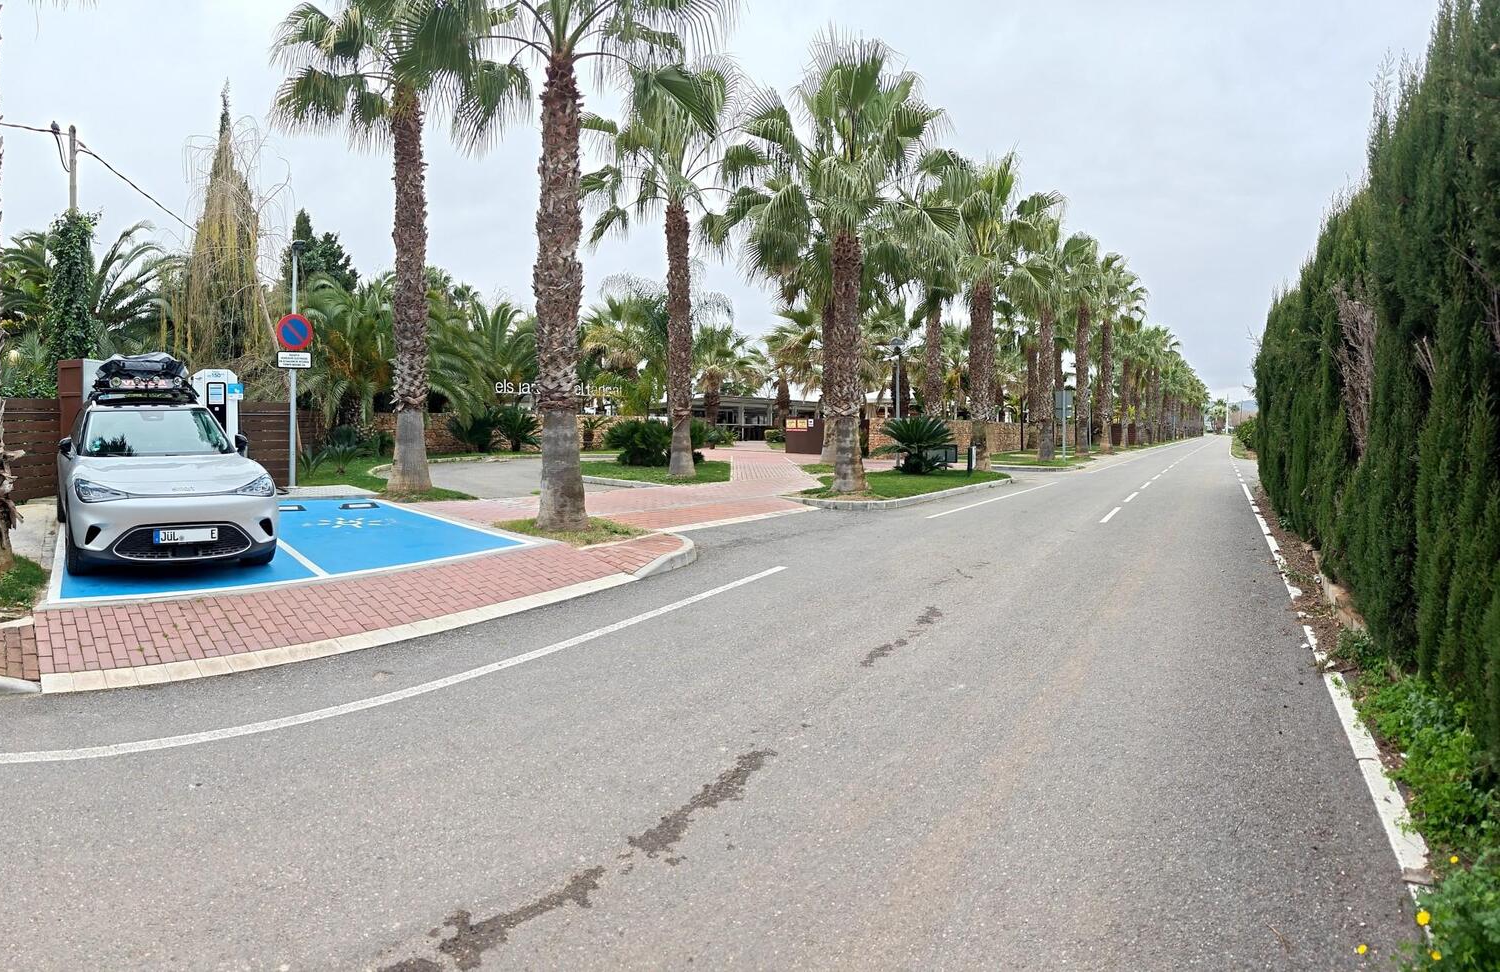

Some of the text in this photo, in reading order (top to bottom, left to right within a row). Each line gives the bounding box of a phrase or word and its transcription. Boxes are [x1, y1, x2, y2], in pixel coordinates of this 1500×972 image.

[495, 379, 514, 393] els
[160, 529, 217, 542] JÜL E
